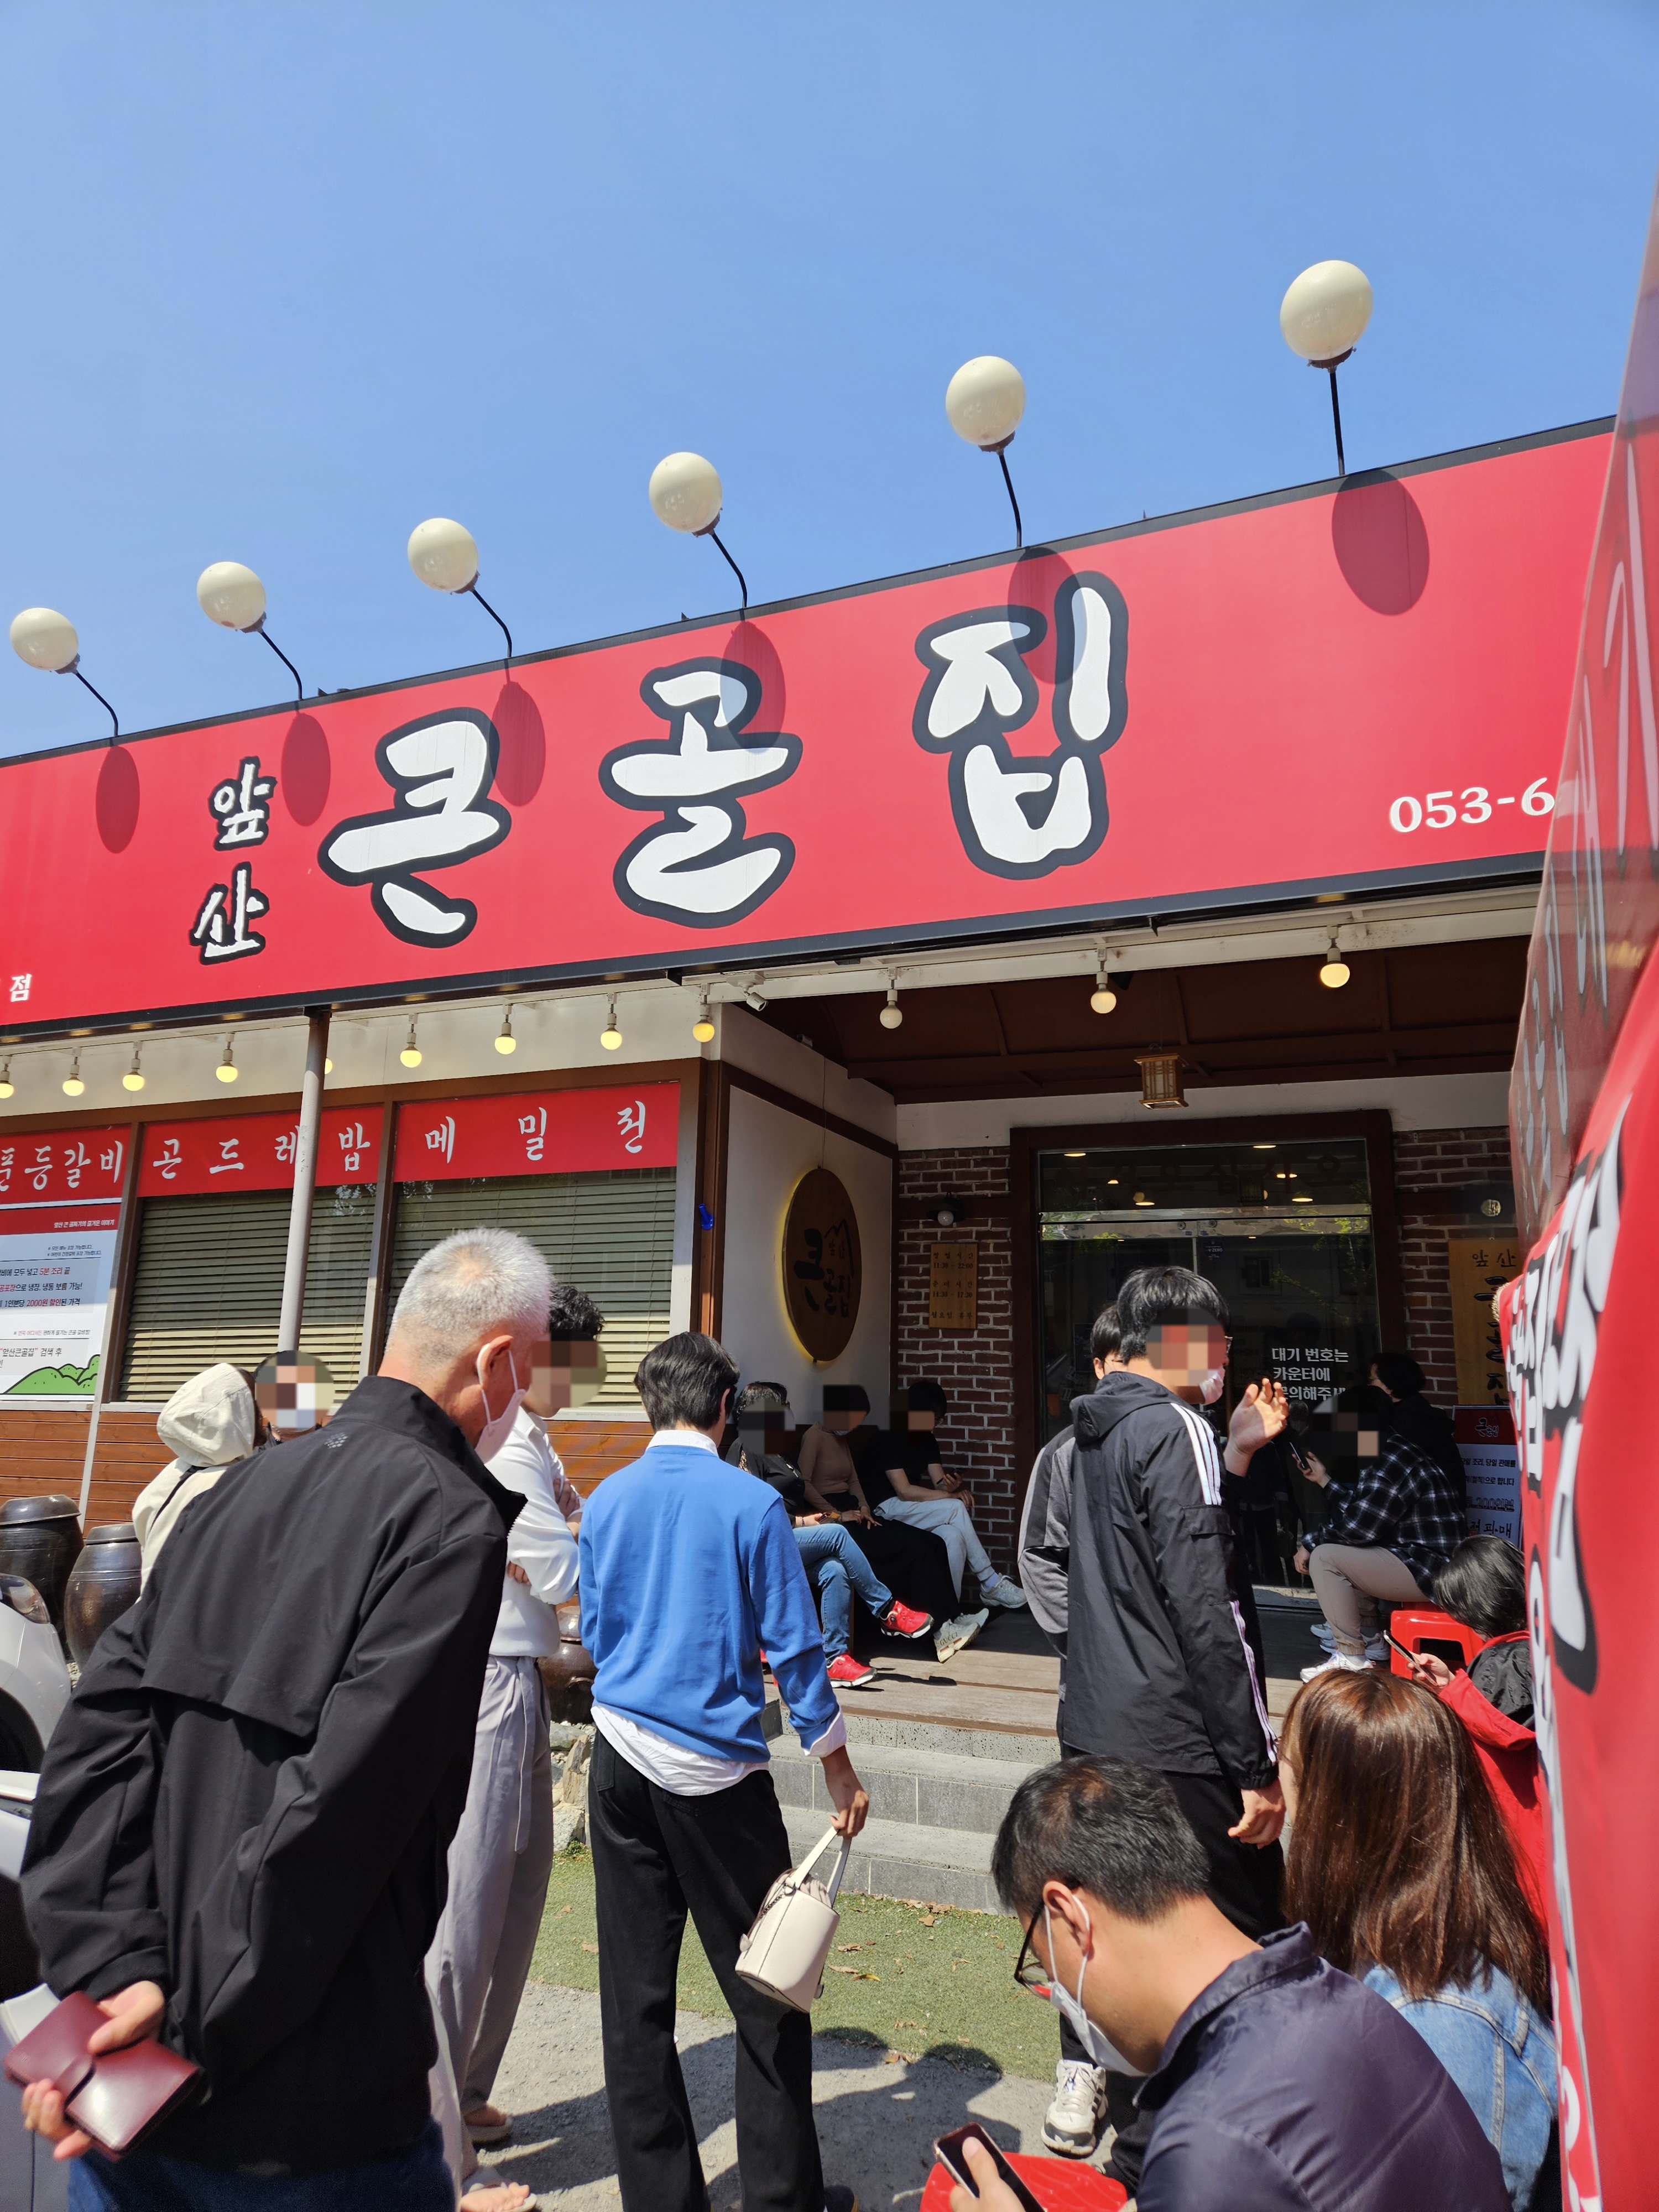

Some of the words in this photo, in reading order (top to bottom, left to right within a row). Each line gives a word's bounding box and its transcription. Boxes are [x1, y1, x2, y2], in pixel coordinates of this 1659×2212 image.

[189, 757, 276, 965] 앞산
[10, 973, 32, 1002] 점
[152, 1122, 371, 1180] 곤드레밥
[26, 1298, 48, 1307] 2000원
[68, 1298, 81, 1306] 가격
[40, 1348, 54, 1357] 검색
[55, 1347, 62, 1357] 후
[1272, 1347, 1300, 1362] 대기
[1305, 1348, 1349, 1363] 번호는
[1273, 1366, 1331, 1381] 카운터에
[1497, 1477, 1515, 1486] 합니다
[940, 1631, 958, 1646] GUCCI
